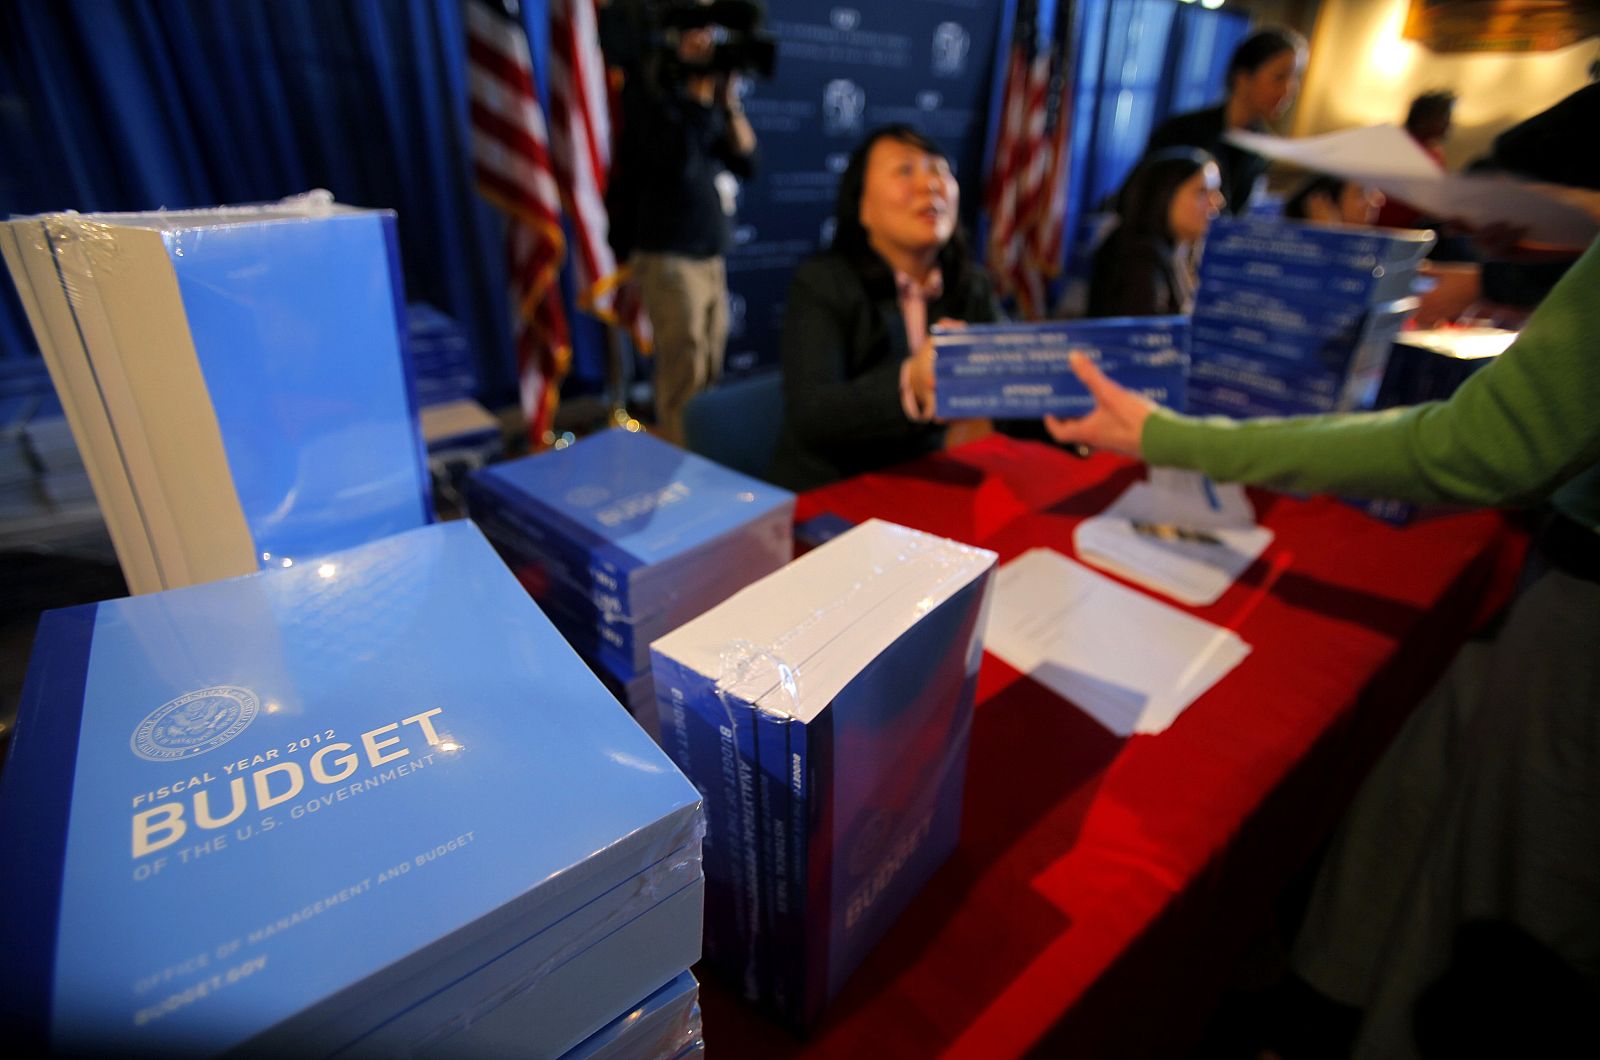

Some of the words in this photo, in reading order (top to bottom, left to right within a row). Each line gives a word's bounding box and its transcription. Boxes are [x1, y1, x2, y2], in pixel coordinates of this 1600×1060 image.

[132, 772, 216, 808] FISCAL
[223, 748, 280, 775] YEAR
[287, 729, 336, 753] 2012
[132, 706, 443, 859] BUDGET
[719, 724, 737, 786] BUDGET
[793, 753, 802, 790] BUDGET
[133, 856, 168, 882] OF
[179, 835, 228, 865] THE
[236, 816, 283, 841] U.S.
[290, 754, 434, 820] GOVERNMENT
[247, 878, 372, 945] MANAGEMENT
[377, 861, 412, 886] AND
[414, 831, 476, 867] BUDGET
